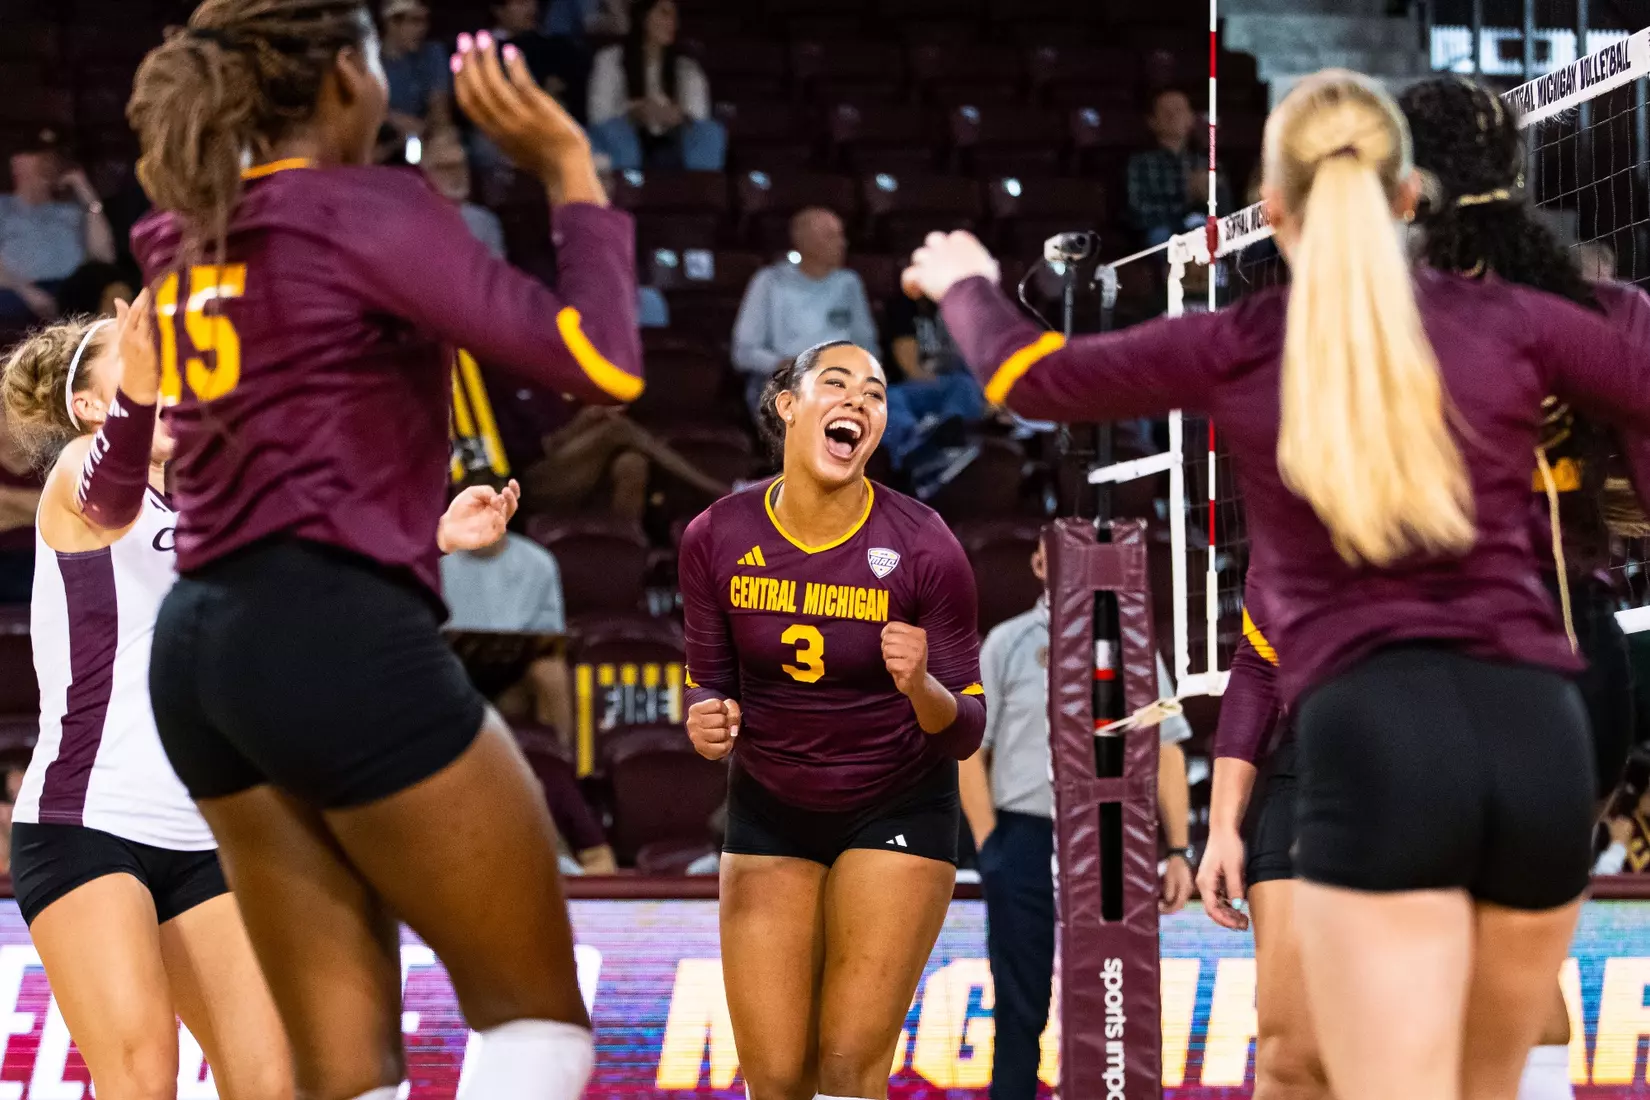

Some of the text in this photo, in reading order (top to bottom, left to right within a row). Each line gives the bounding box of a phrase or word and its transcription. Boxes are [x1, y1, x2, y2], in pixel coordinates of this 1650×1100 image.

[1537, 64, 1577, 108] MICHIGAN
[1580, 39, 1631, 90] VOLLEYBALL
[157, 264, 247, 404] 15
[730, 576, 889, 622] CENTRAL MICHIGAN
[781, 624, 825, 683] 3
[1100, 958, 1127, 1038] sports
